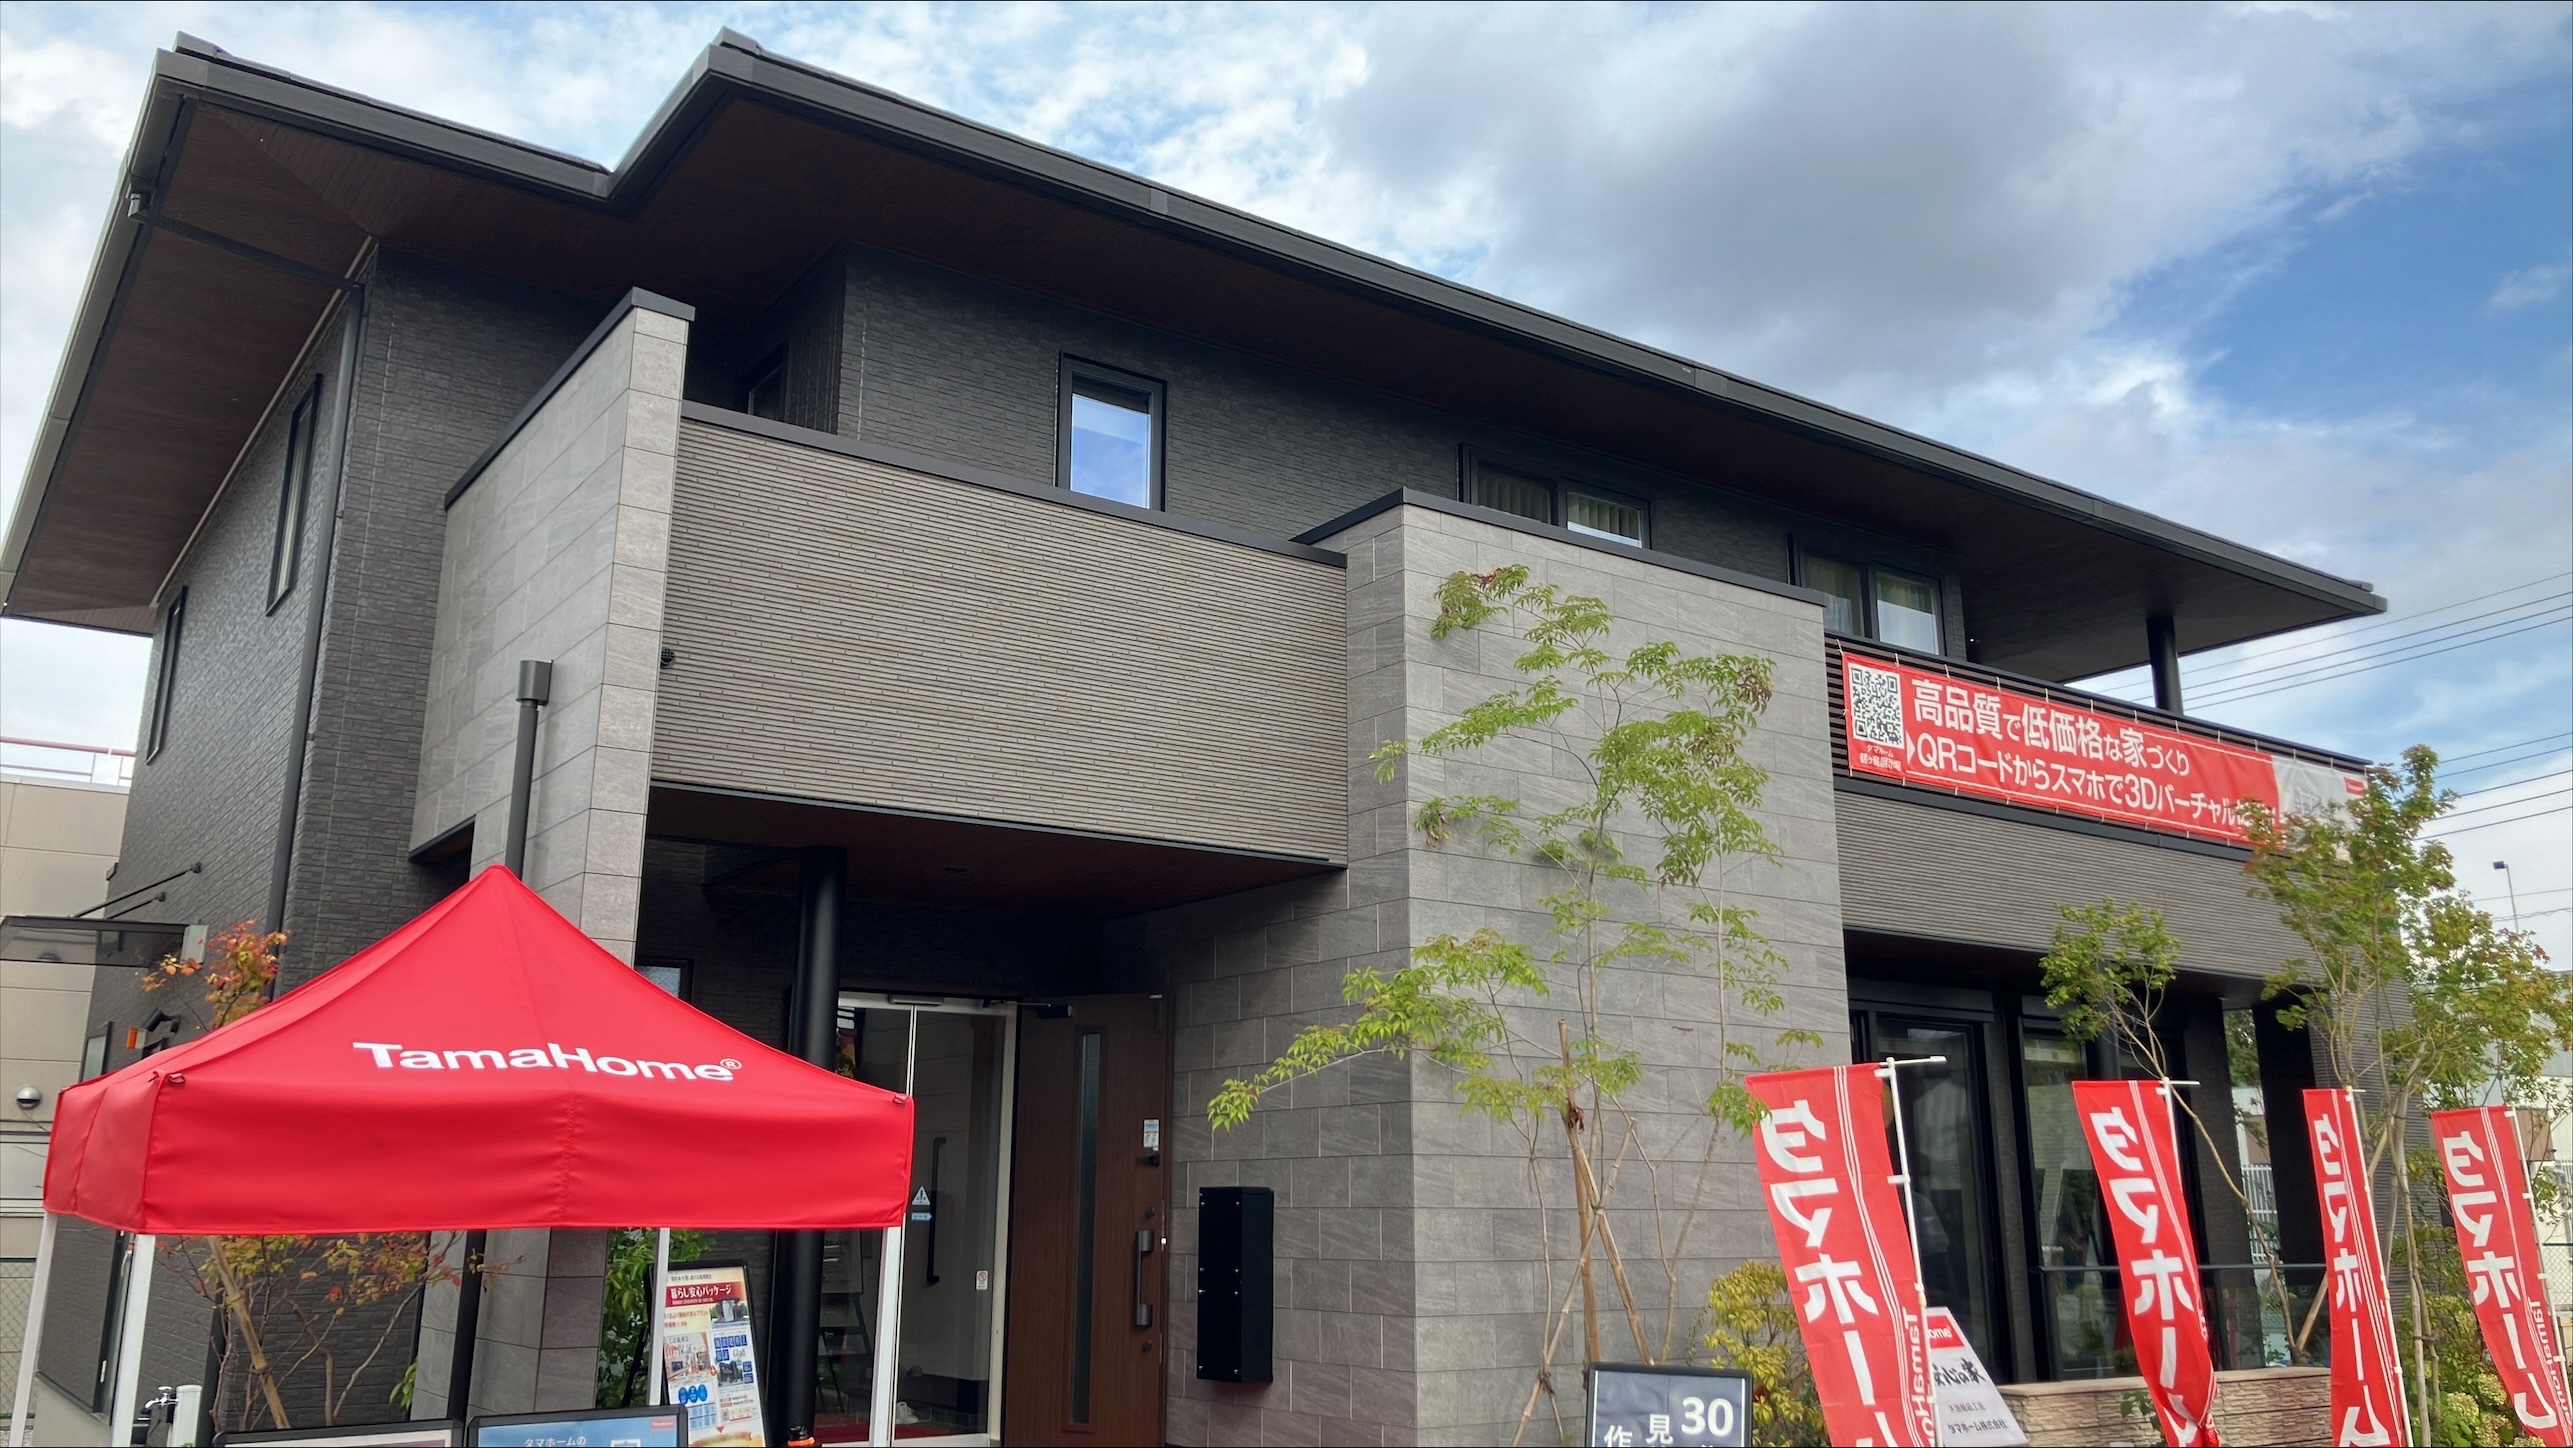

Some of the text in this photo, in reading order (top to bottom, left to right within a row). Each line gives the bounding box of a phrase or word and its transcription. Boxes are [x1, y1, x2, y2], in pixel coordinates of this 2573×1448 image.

[1911, 678, 2190, 776] 高品質で低価格な家づくり
